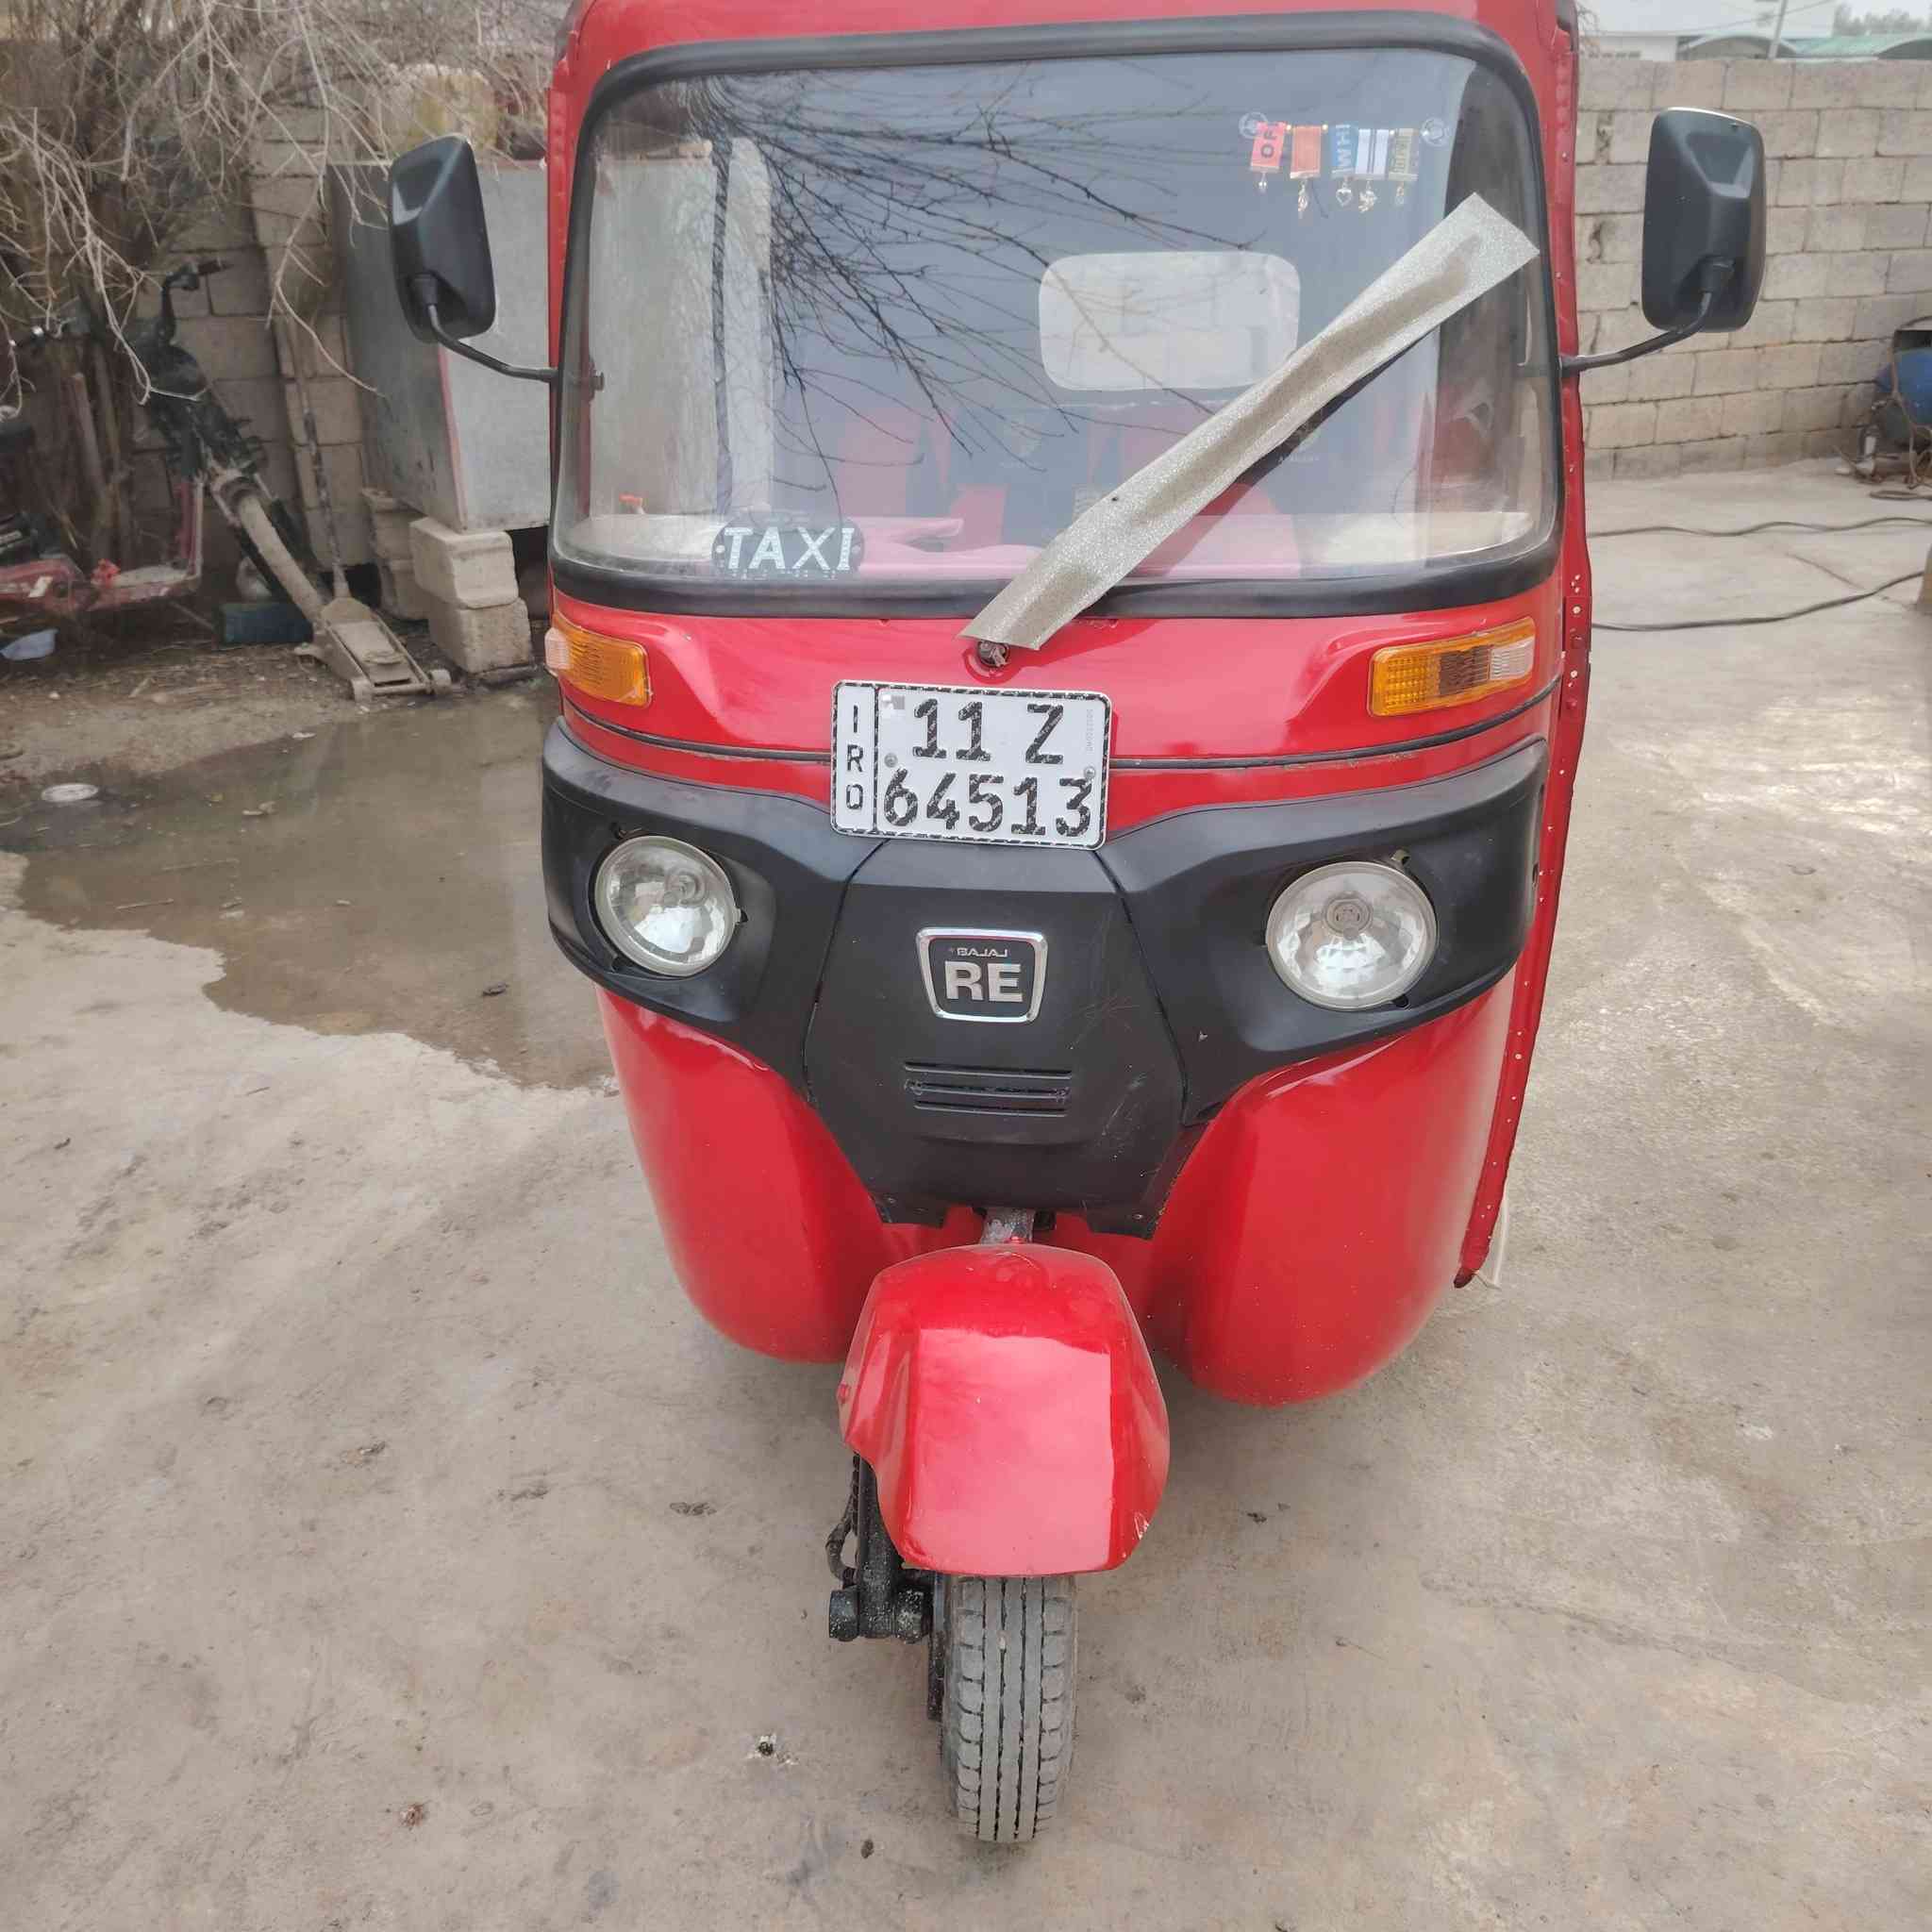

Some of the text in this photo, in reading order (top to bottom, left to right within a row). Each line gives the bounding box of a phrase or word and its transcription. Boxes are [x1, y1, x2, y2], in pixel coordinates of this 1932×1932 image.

[724, 526, 855, 570] TAXI
[913, 698, 991, 761] 11
[1025, 704, 1064, 765] Z
[883, 768, 1092, 838] 64513
[957, 947, 1008, 958] BAJAJ
[944, 960, 1023, 1002] RE
